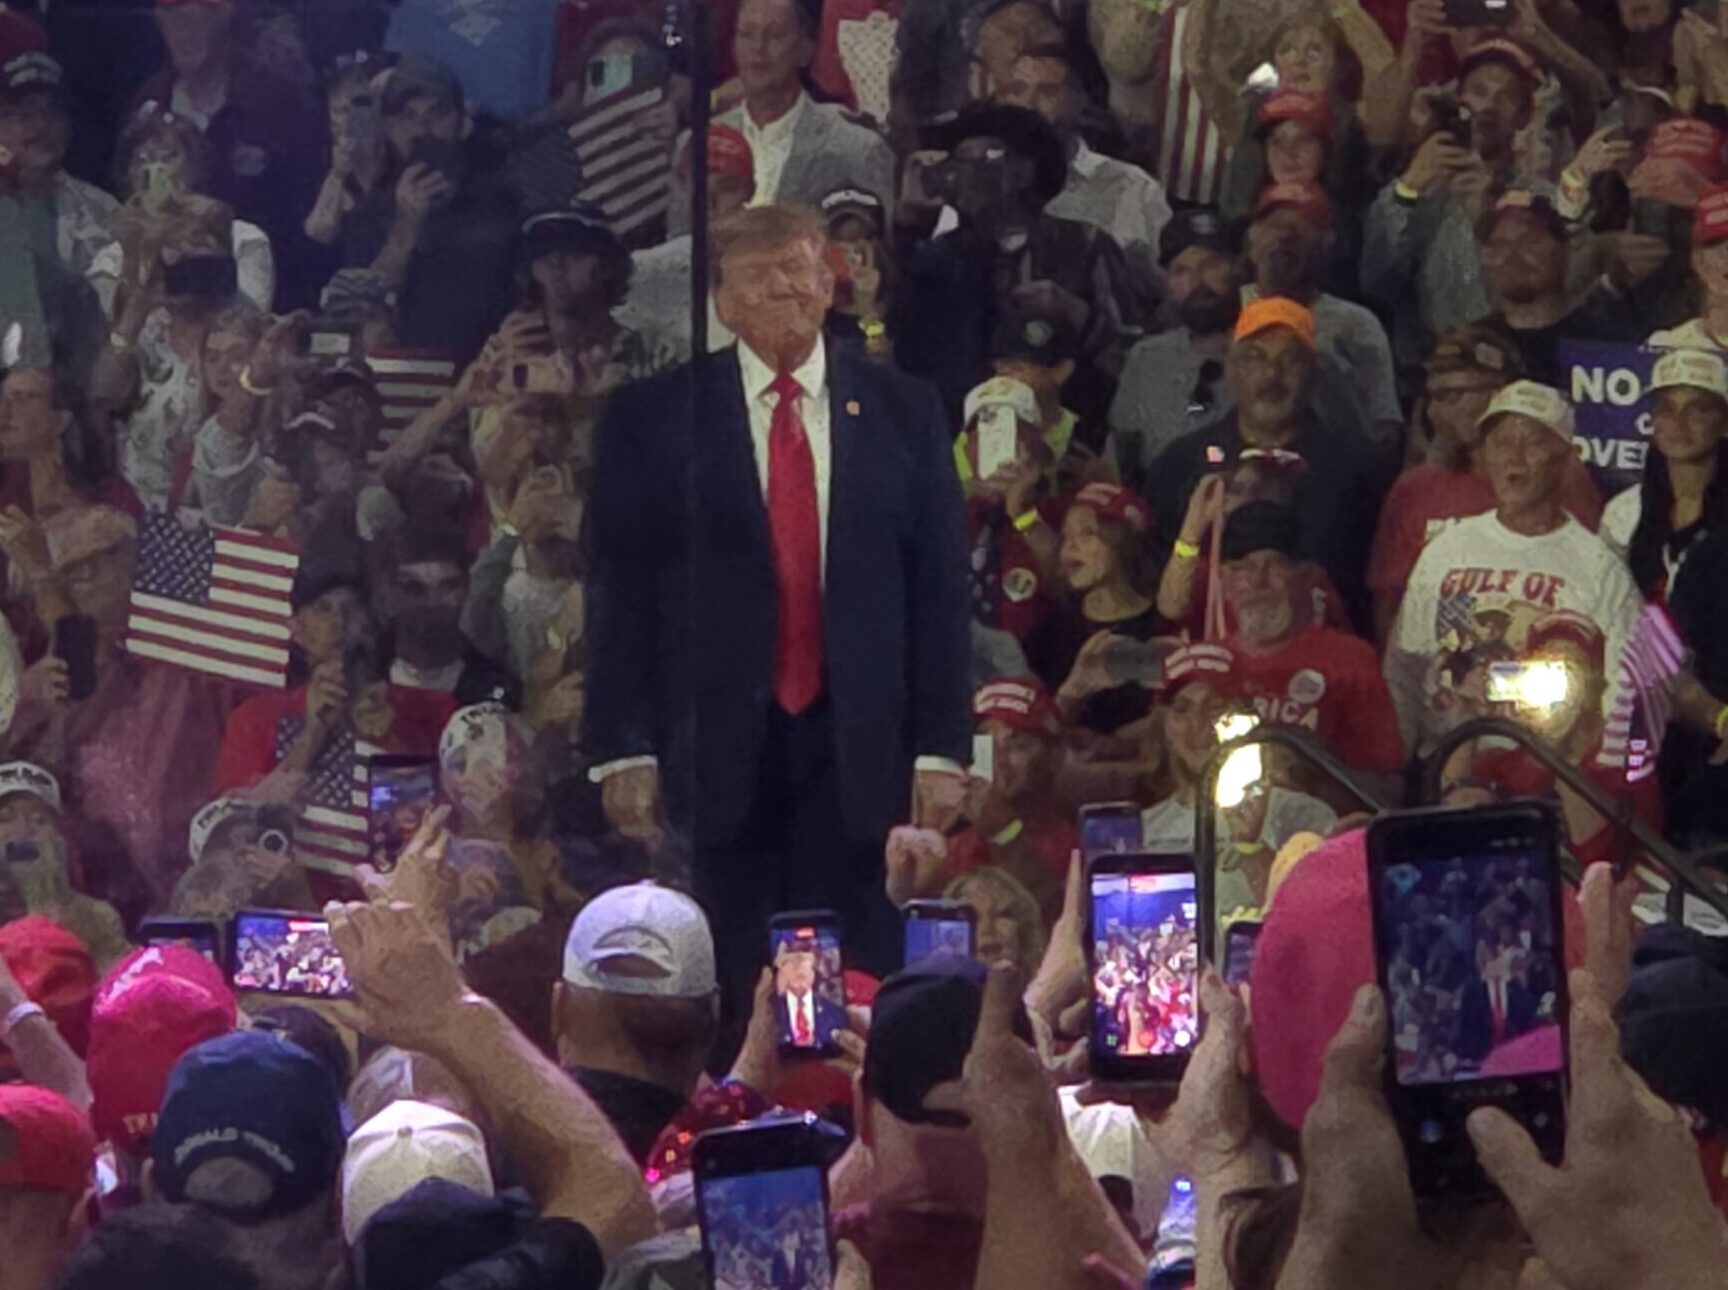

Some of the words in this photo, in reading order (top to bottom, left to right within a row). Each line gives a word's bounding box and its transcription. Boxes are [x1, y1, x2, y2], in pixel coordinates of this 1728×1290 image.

[1571, 365, 1641, 406] NO
[1571, 436, 1650, 469] OVE
[1440, 567, 1518, 600] GULF
[1523, 572, 1565, 607] OF
[1253, 697, 1319, 732] RICA
